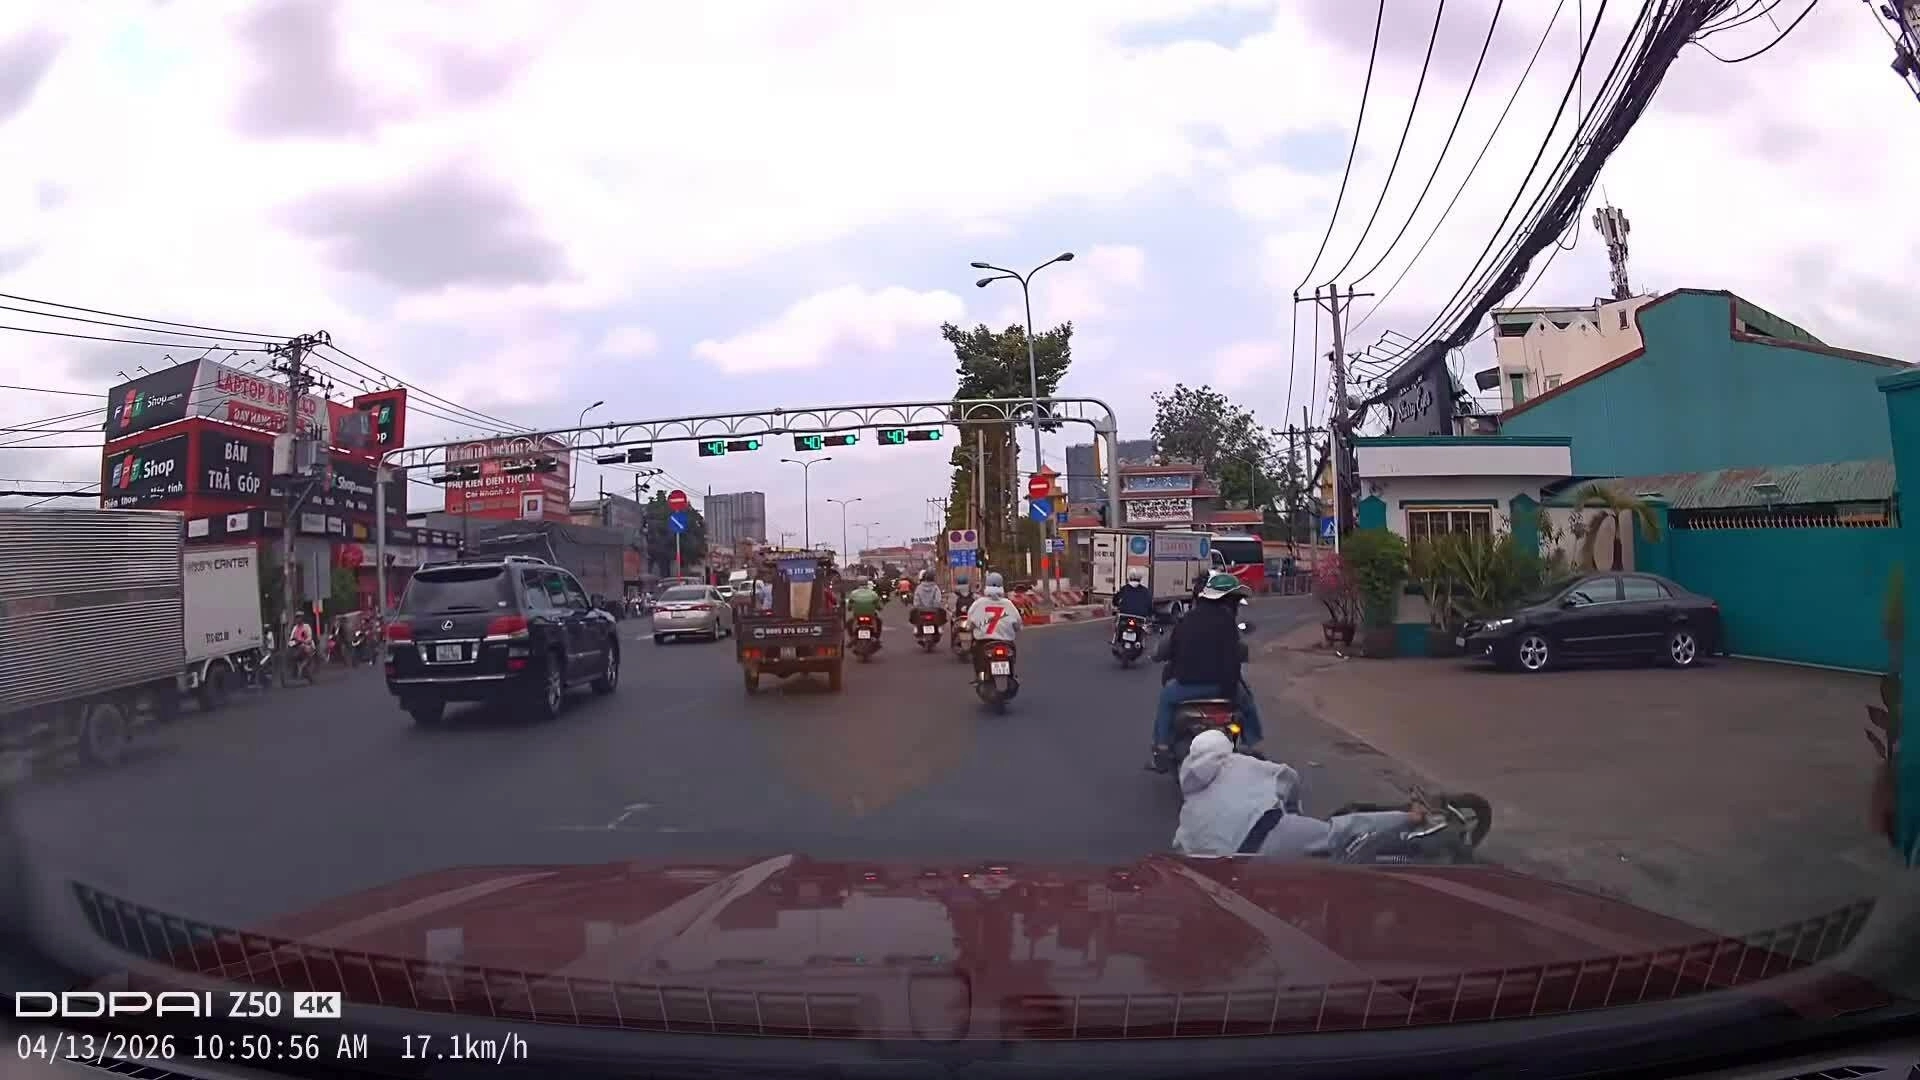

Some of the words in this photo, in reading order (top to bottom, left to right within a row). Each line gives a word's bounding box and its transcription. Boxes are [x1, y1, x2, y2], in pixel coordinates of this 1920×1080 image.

[113, 389, 145, 427] FPT
[706, 442, 723, 455] 40
[803, 435, 821, 449] 40
[886, 430, 904, 444] 40
[225, 441, 248, 463] BÁN
[112, 455, 142, 489] FPT
[143, 459, 174, 479] Shop
[208, 467, 231, 490] TRẢ
[238, 472, 261, 494] GÓP
[984, 606, 1005, 635] 7
